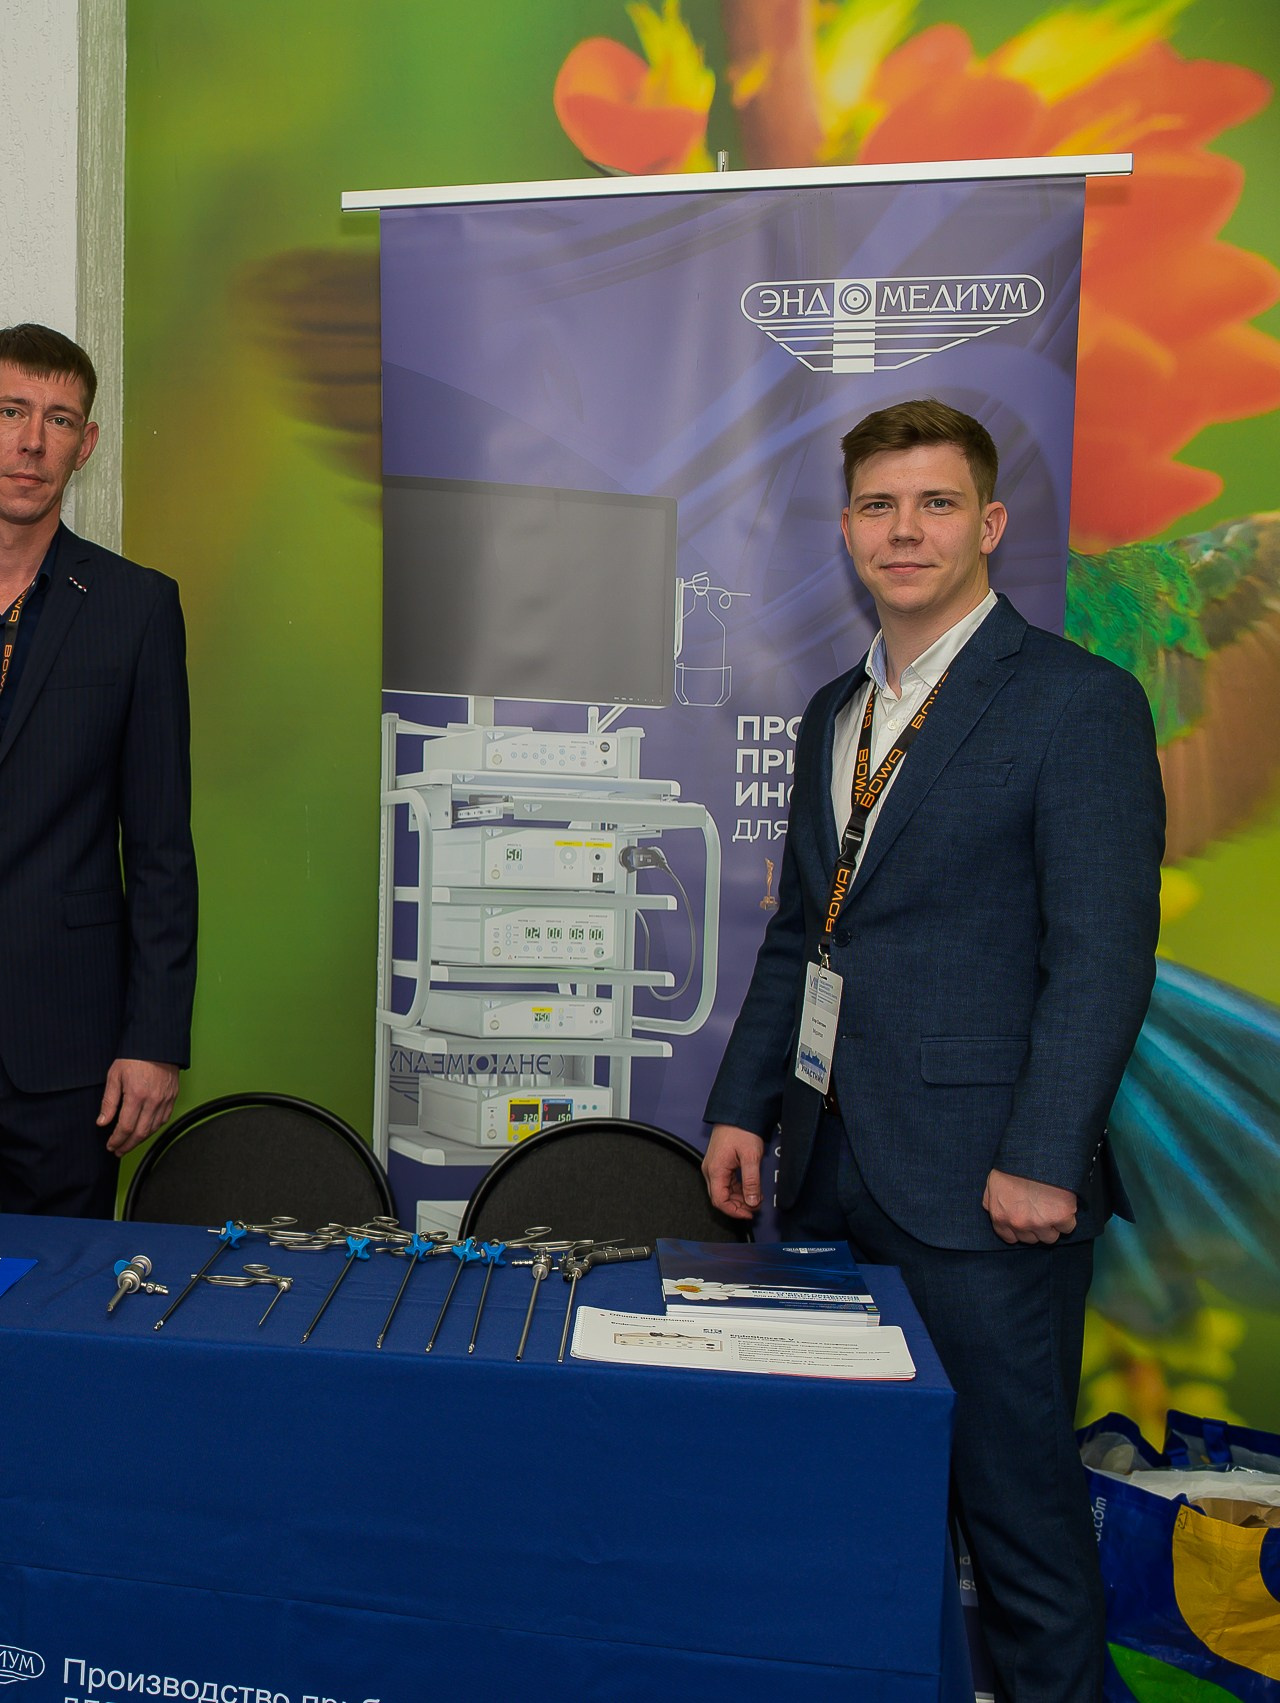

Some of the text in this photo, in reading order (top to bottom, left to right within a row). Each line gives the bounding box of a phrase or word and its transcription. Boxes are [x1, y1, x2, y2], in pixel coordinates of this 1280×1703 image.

[758, 281, 1029, 317] ЭНДОМЕДИУМ
[735, 781, 795, 808] ИН
[860, 748, 904, 808] BOWA
[732, 819, 789, 843] ДЛЯ
[63, 1657, 290, 1703] Производство
